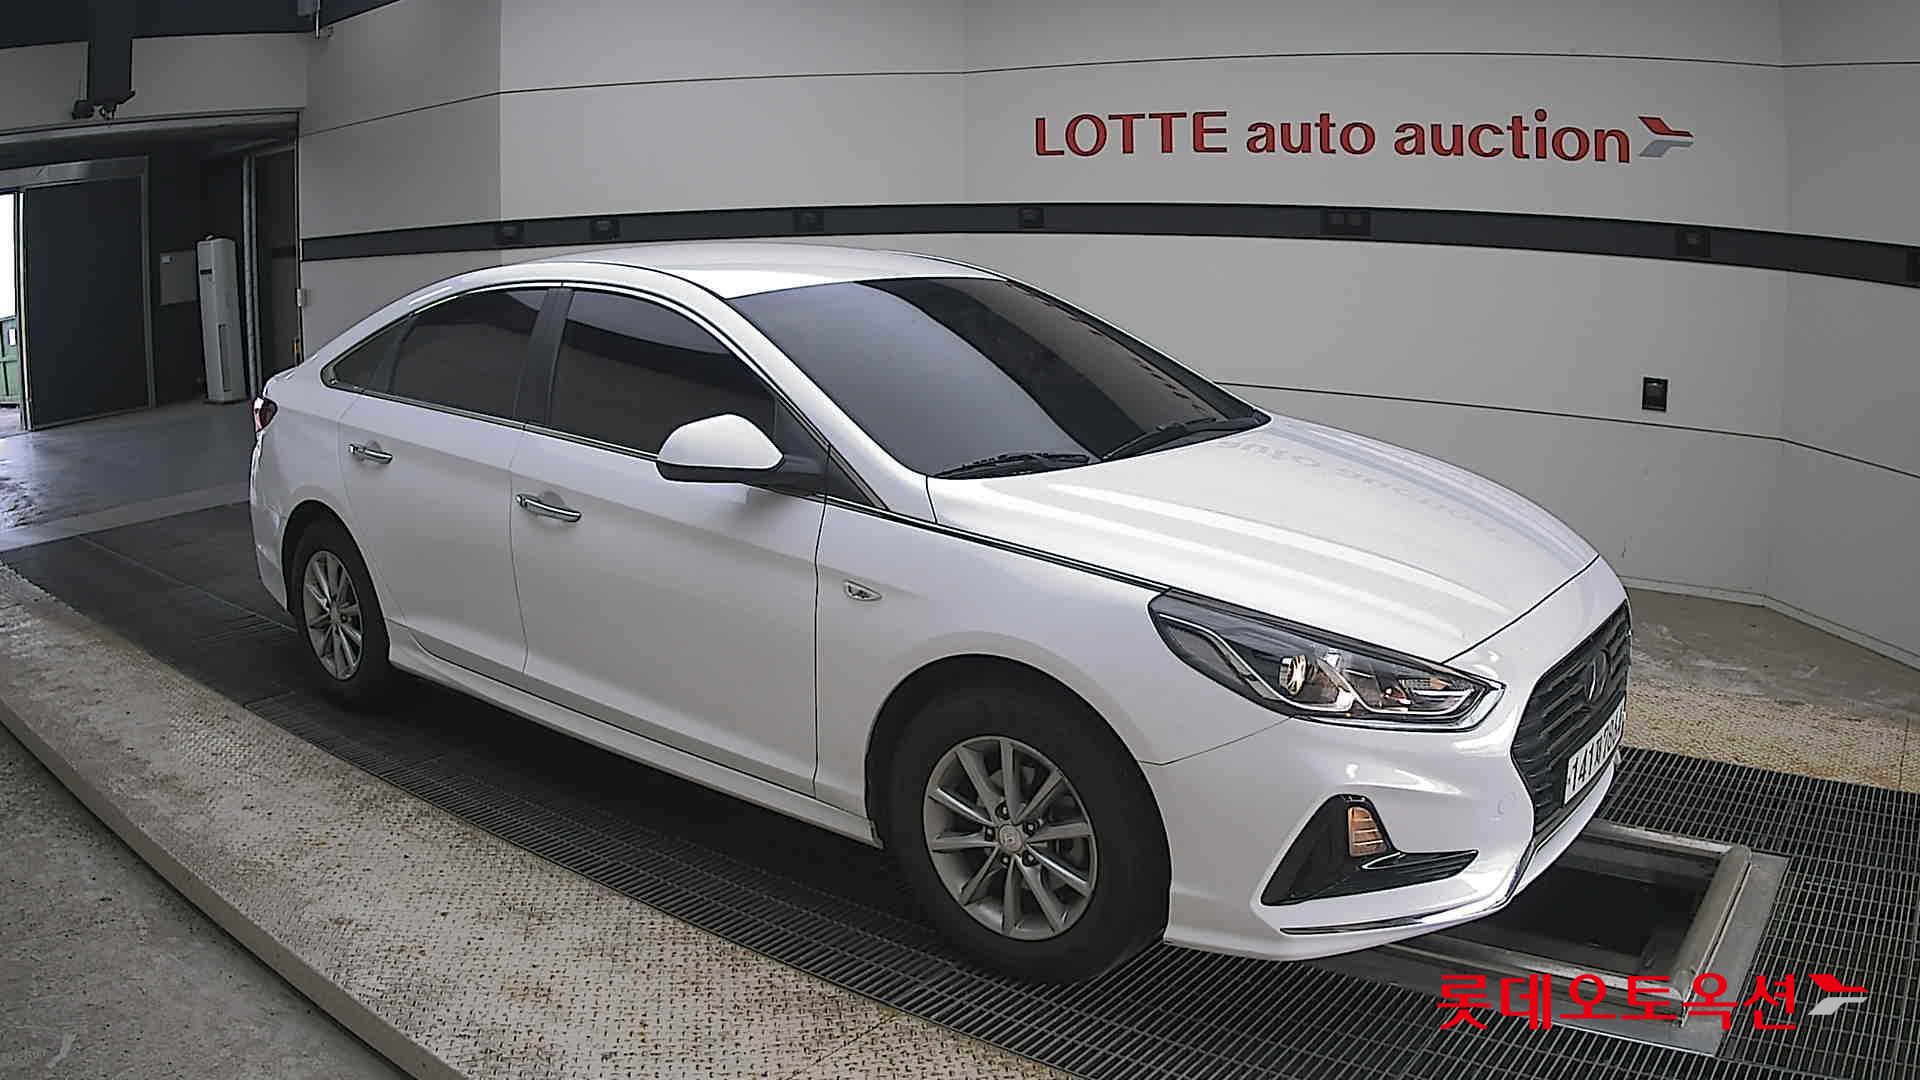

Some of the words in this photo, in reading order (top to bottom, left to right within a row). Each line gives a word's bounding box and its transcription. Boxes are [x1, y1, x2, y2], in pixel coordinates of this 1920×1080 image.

[1035, 111, 1228, 156] LOTTE
[1246, 113, 1376, 155] auto
[1394, 109, 1631, 163] auction
